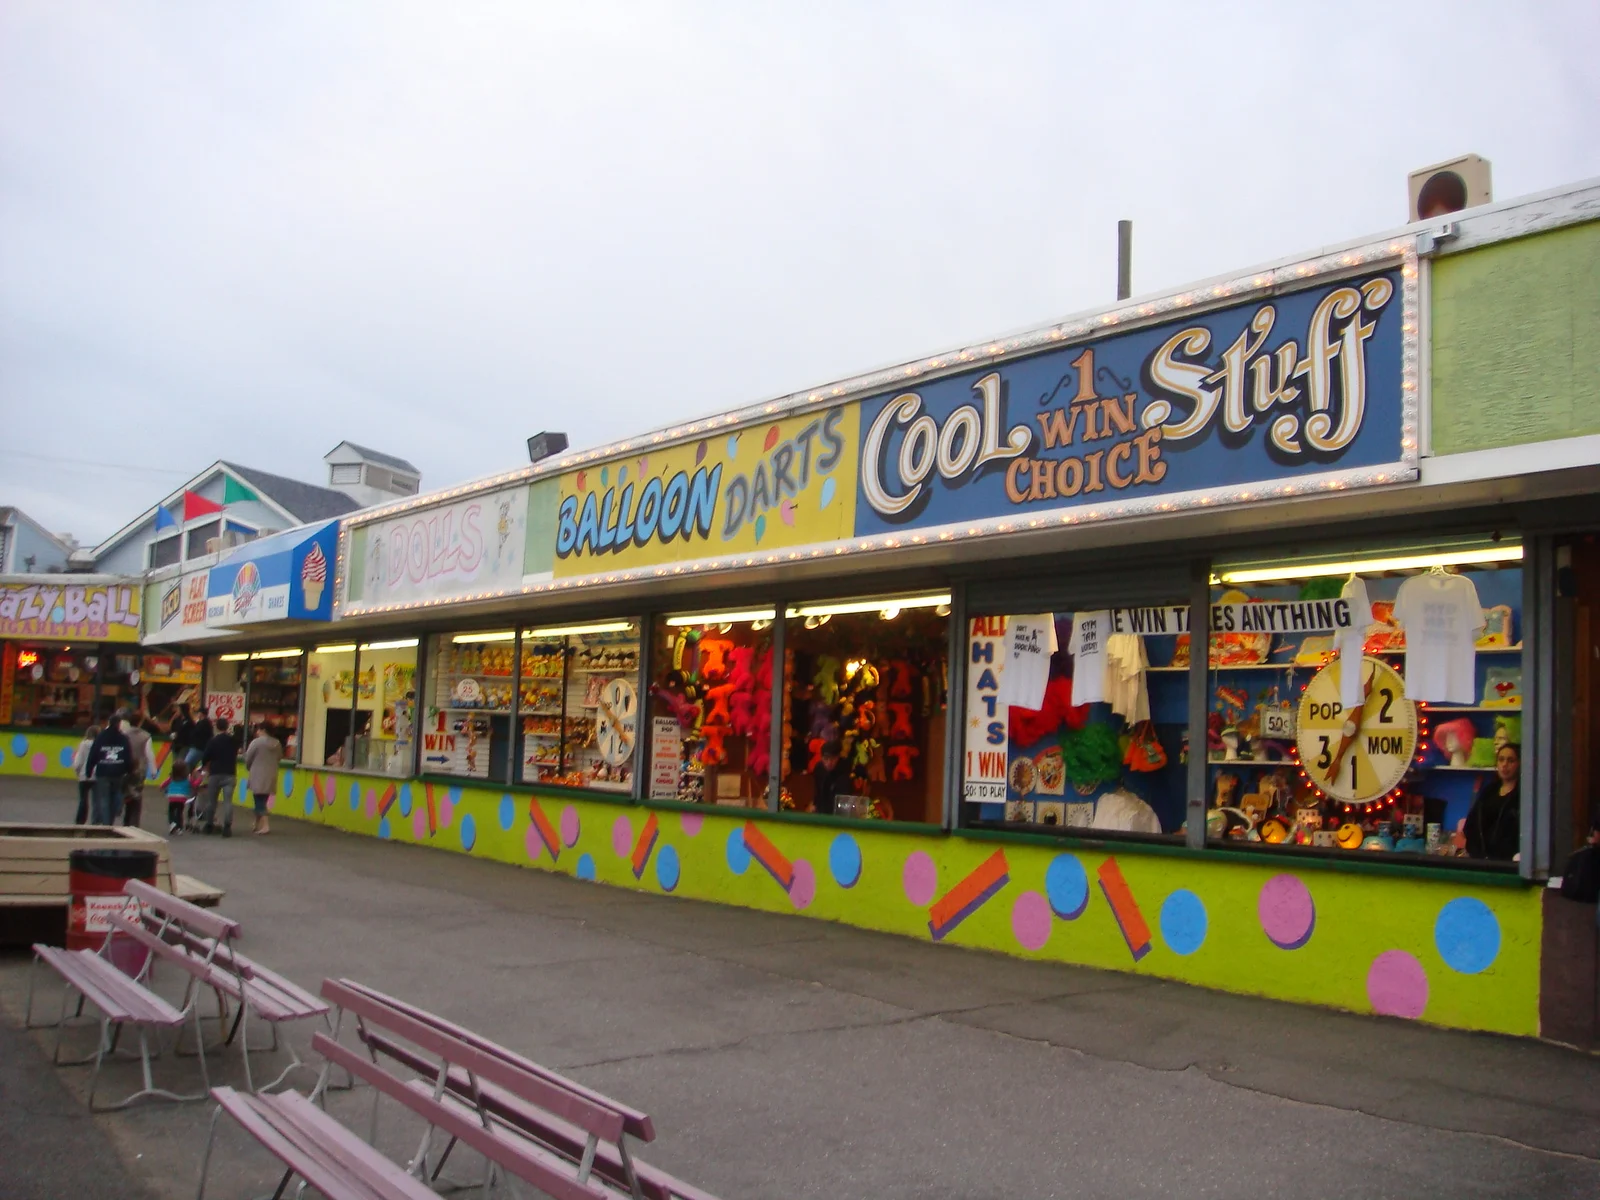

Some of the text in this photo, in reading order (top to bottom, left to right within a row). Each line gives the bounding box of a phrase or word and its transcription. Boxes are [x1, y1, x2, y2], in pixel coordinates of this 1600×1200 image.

[1069, 348, 1099, 405] 1
[1036, 392, 1137, 450] WIN
[555, 405, 845, 560] BALLOON DARTS
[1004, 426, 1169, 505] CHOICE
[387, 503, 484, 587] DOLLS
[972, 616, 1006, 637] ALL
[1081, 620, 1097, 631] GYM
[1129, 606, 1167, 633] WIN
[1242, 599, 1352, 631] ANYTHING
[207, 694, 232, 709] PICK
[972, 641, 1005, 745] HATS
[1379, 688, 1394, 724] 2
[436, 711, 446, 732] 1
[1309, 702, 1342, 720] POP
[425, 734, 456, 752] WIN
[1317, 735, 1332, 769] 3
[1368, 736, 1403, 755] MOM
[968, 751, 1006, 779] 1 WIN
[1351, 755, 1357, 790] 1
[979, 786, 988, 798] TO
[990, 785, 1006, 798] PLAY
